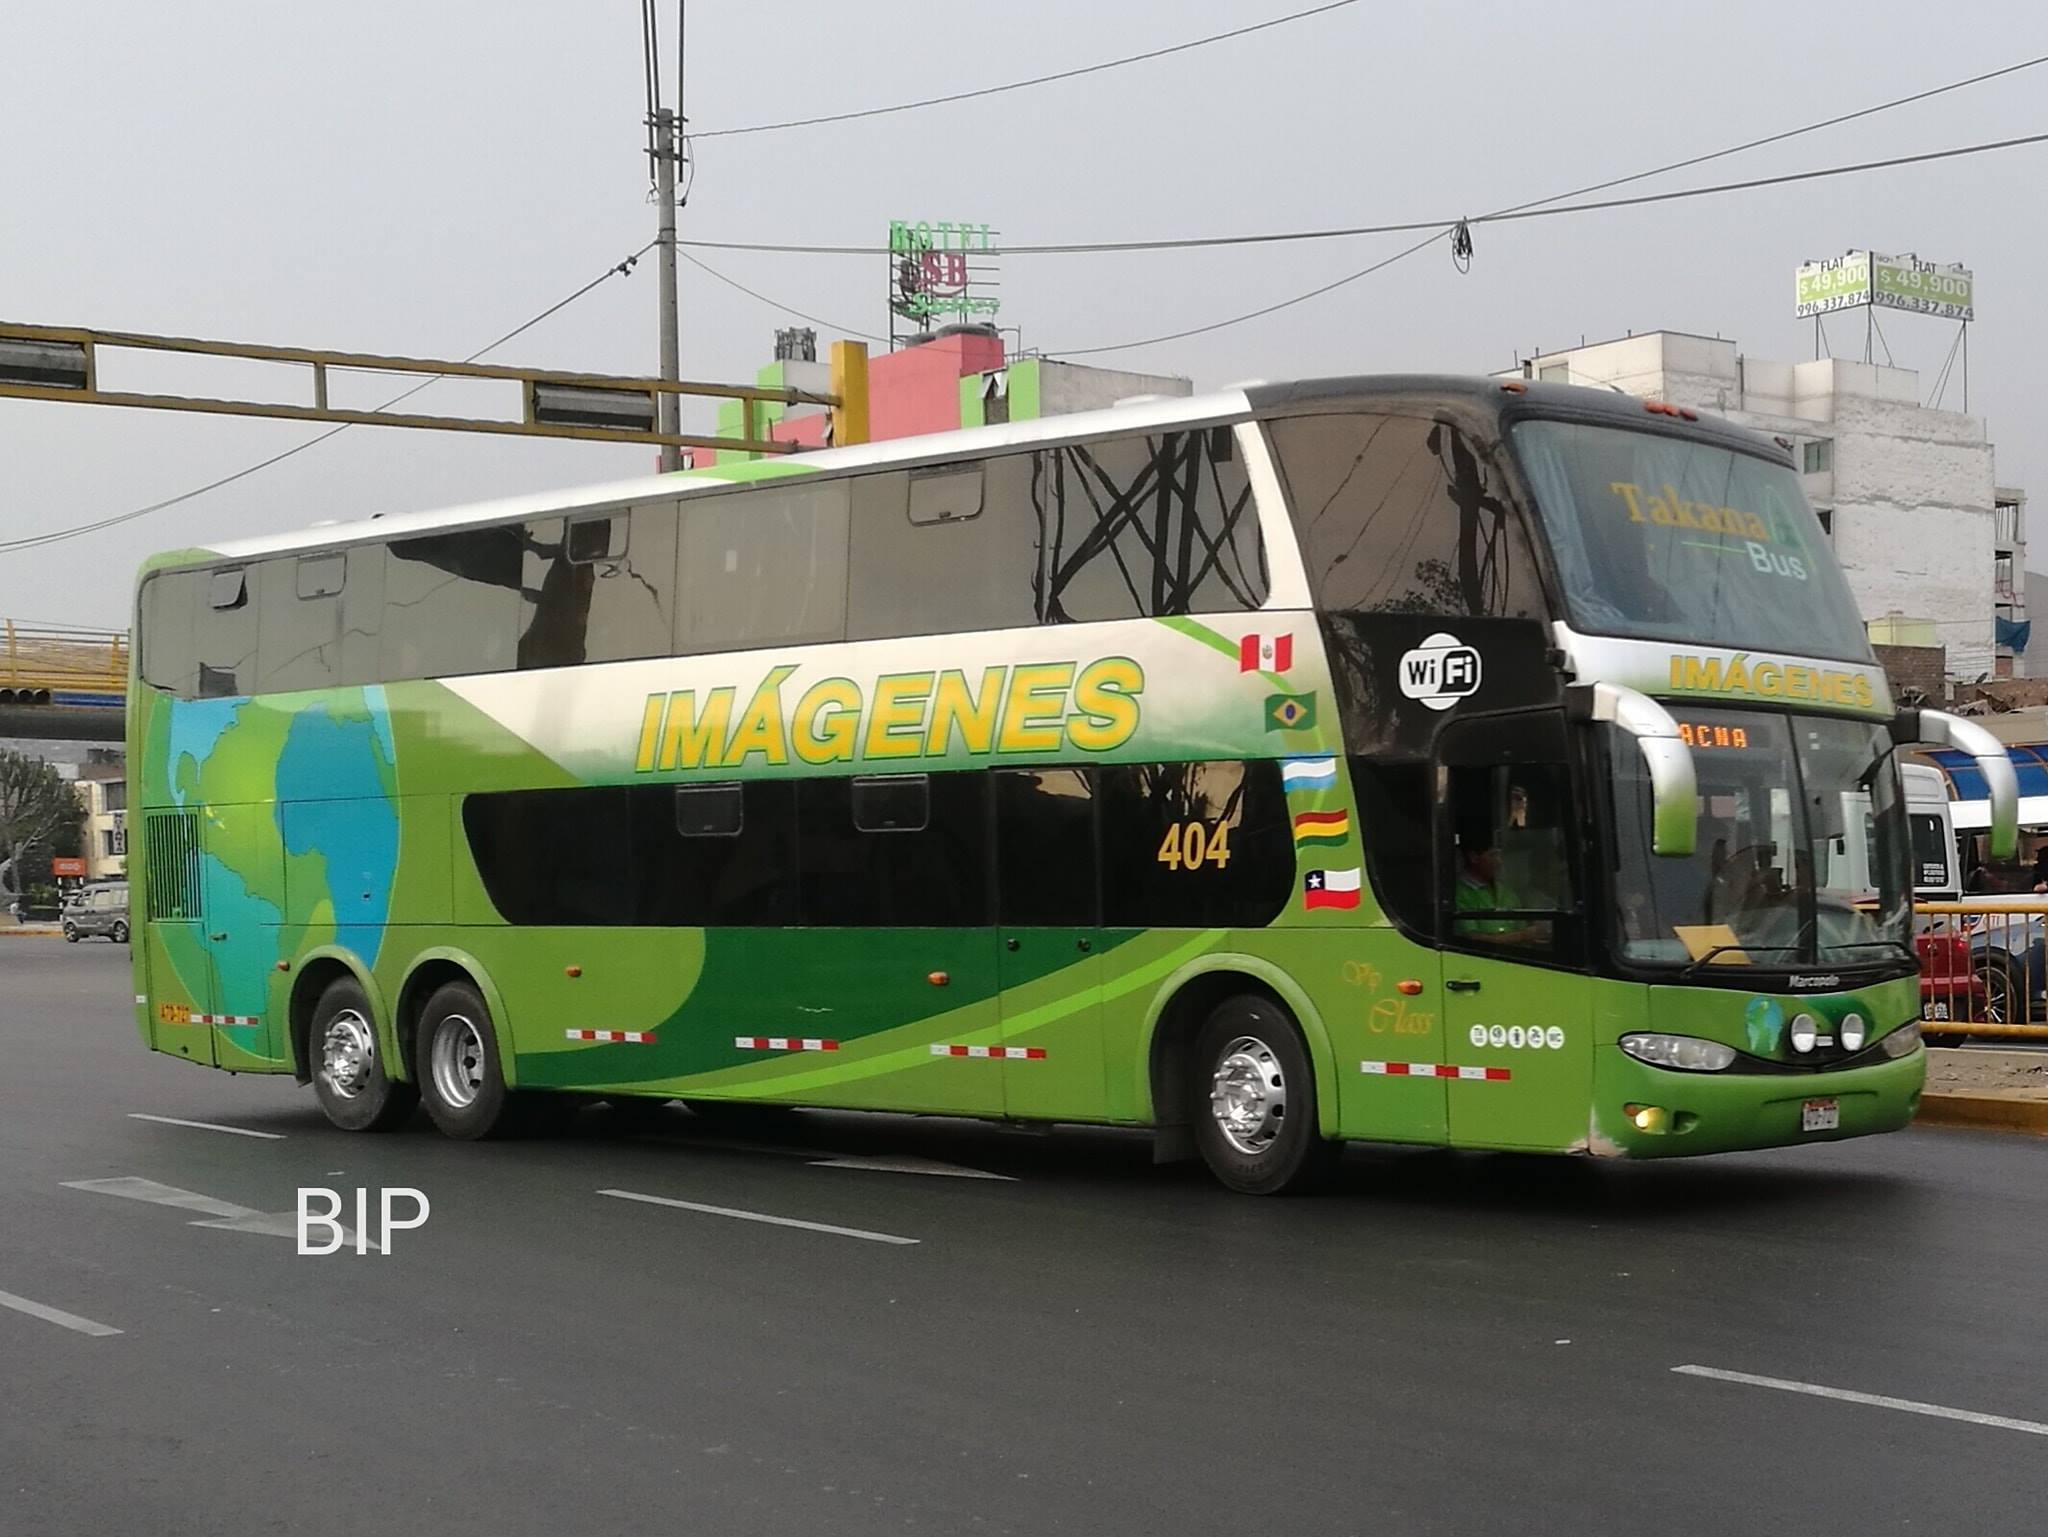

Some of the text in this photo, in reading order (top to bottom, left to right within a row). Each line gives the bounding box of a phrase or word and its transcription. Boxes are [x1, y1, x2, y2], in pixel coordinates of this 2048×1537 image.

[889, 220, 995, 252] HOTEL
[921, 250, 967, 287] SB
[1820, 256, 1845, 272] FLAT
[1912, 259, 1937, 274] FLAT
[1800, 265, 1867, 295] $ 49,900
[1880, 269, 1890, 284] $
[1896, 270, 1968, 297] 49,900
[1797, 290, 1870, 316] 996.337.874
[1875, 290, 1974, 318] 996.337.874
[1609, 481, 1770, 542] Takana
[1745, 540, 1808, 581] Bus
[1669, 652, 1874, 708] IMÁGENES
[635, 655, 1144, 772] IMÁGENES
[1677, 723, 1747, 748] ACNA
[1157, 820, 1232, 871] 404
